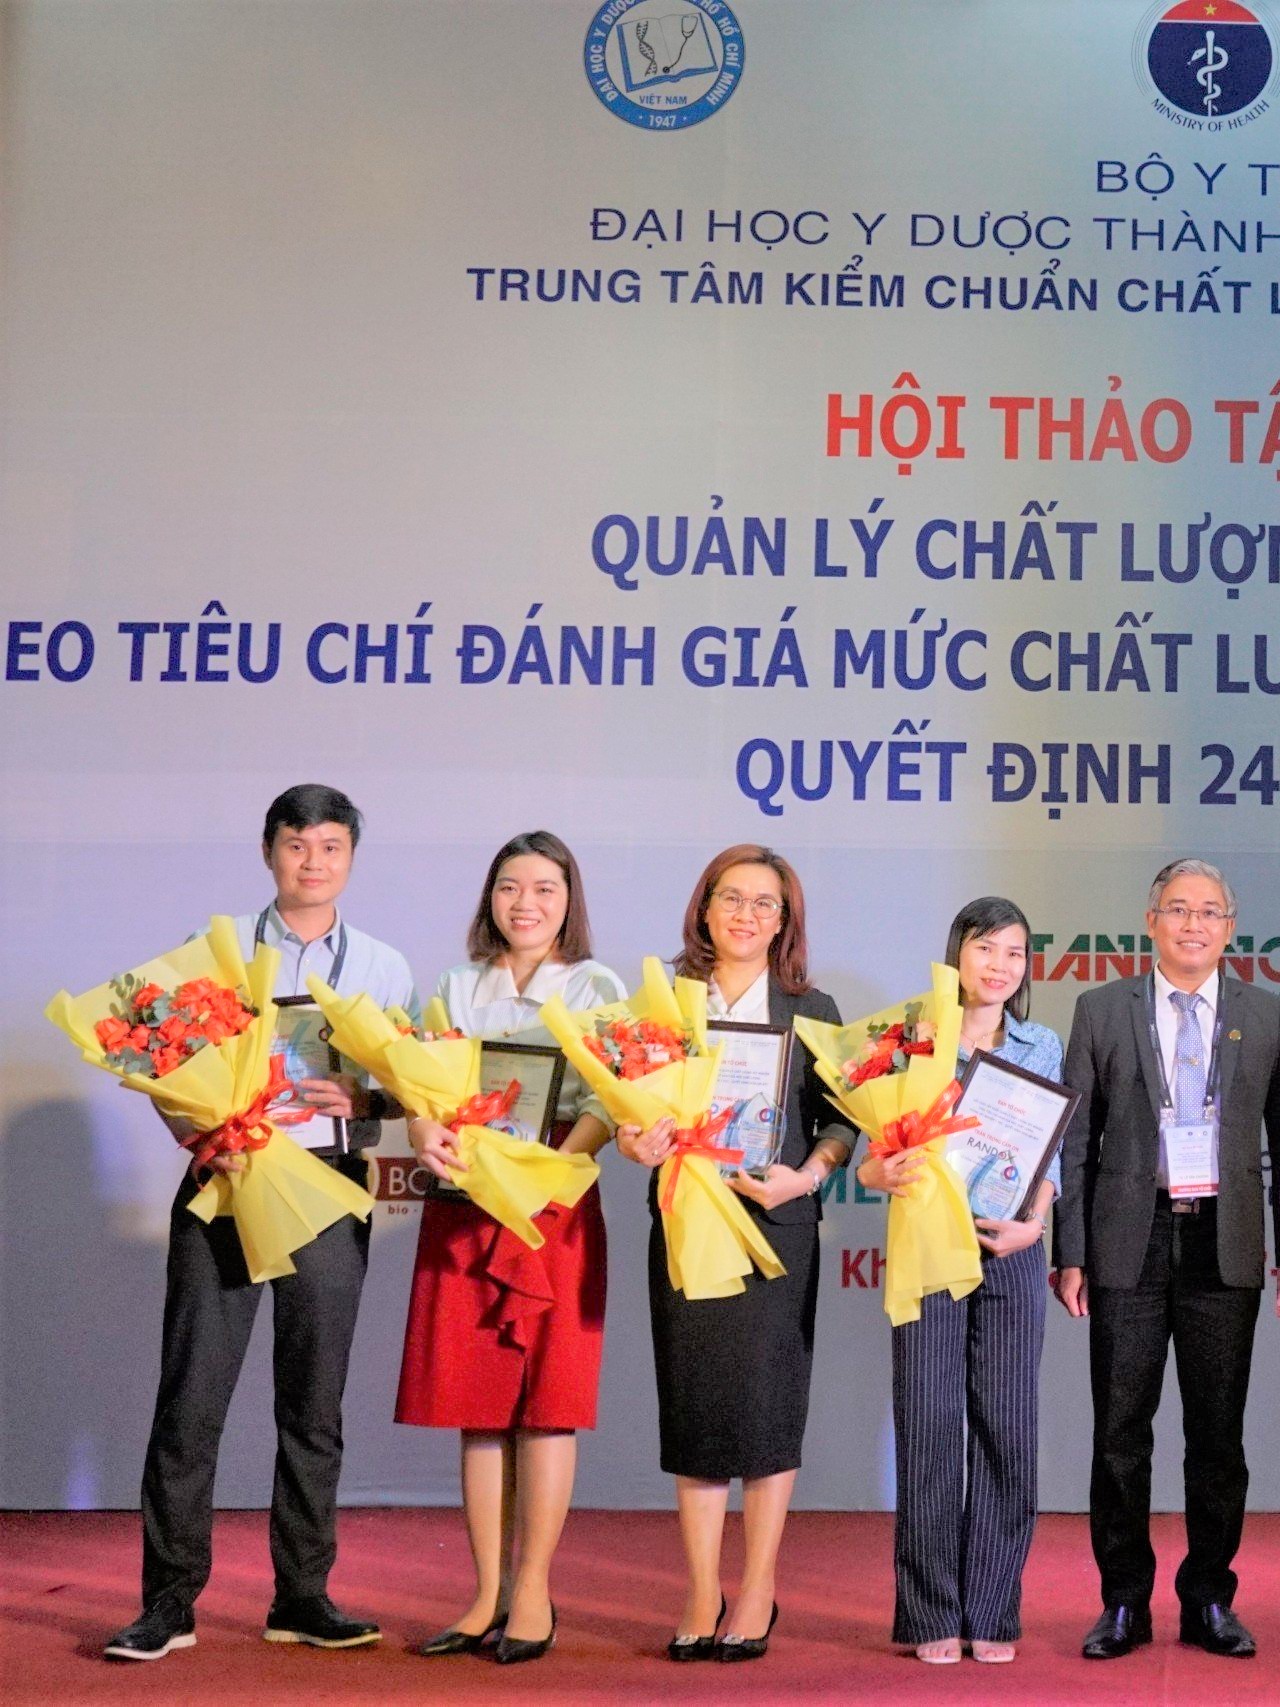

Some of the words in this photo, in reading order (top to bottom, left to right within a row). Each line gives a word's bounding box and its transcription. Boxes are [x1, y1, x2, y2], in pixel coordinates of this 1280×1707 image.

[593, 26, 606, 38] Y
[590, 43, 606, 74] HỌC
[639, 93, 662, 105] VIỆT
[665, 95, 687, 105] NAM
[707, 72, 735, 105] MINH
[649, 114, 676, 128] 1947
[1151, 97, 1204, 132] MINISTRY
[1207, 121, 1224, 132] OF
[1228, 99, 1270, 130] HEALTH
[1097, 152, 1174, 201] BỘ
[1194, 162, 1227, 195] Y
[590, 208, 682, 249] ĐẠI
[708, 209, 828, 251] HỌC
[852, 212, 887, 245] Y
[911, 211, 1070, 256] DƯỢC
[466, 268, 640, 303] TRUNG
[660, 261, 763, 304] TÂM
[785, 255, 904, 307] KIỂM
[925, 257, 1097, 311] CHUẨN
[1118, 264, 1252, 315] CHẤT
[826, 371, 966, 476] HỘI
[989, 376, 1191, 463] THẢO
[592, 495, 786, 591] QUẢN
[814, 498, 894, 578] LÝ
[916, 501, 1097, 582] CHẤT
[118, 600, 281, 684] TIÊU
[306, 602, 433, 684] CHÍ
[456, 603, 655, 686] ĐÁNH
[682, 605, 808, 688] GIÁ
[834, 608, 987, 691] MỨC
[1010, 611, 1192, 692] CHẤT
[736, 719, 967, 816] QUYẾT
[987, 743, 1170, 820] ĐỊNH
[966, 1136, 1016, 1164] RANDOX
[388, 1204, 409, 1215] bio
